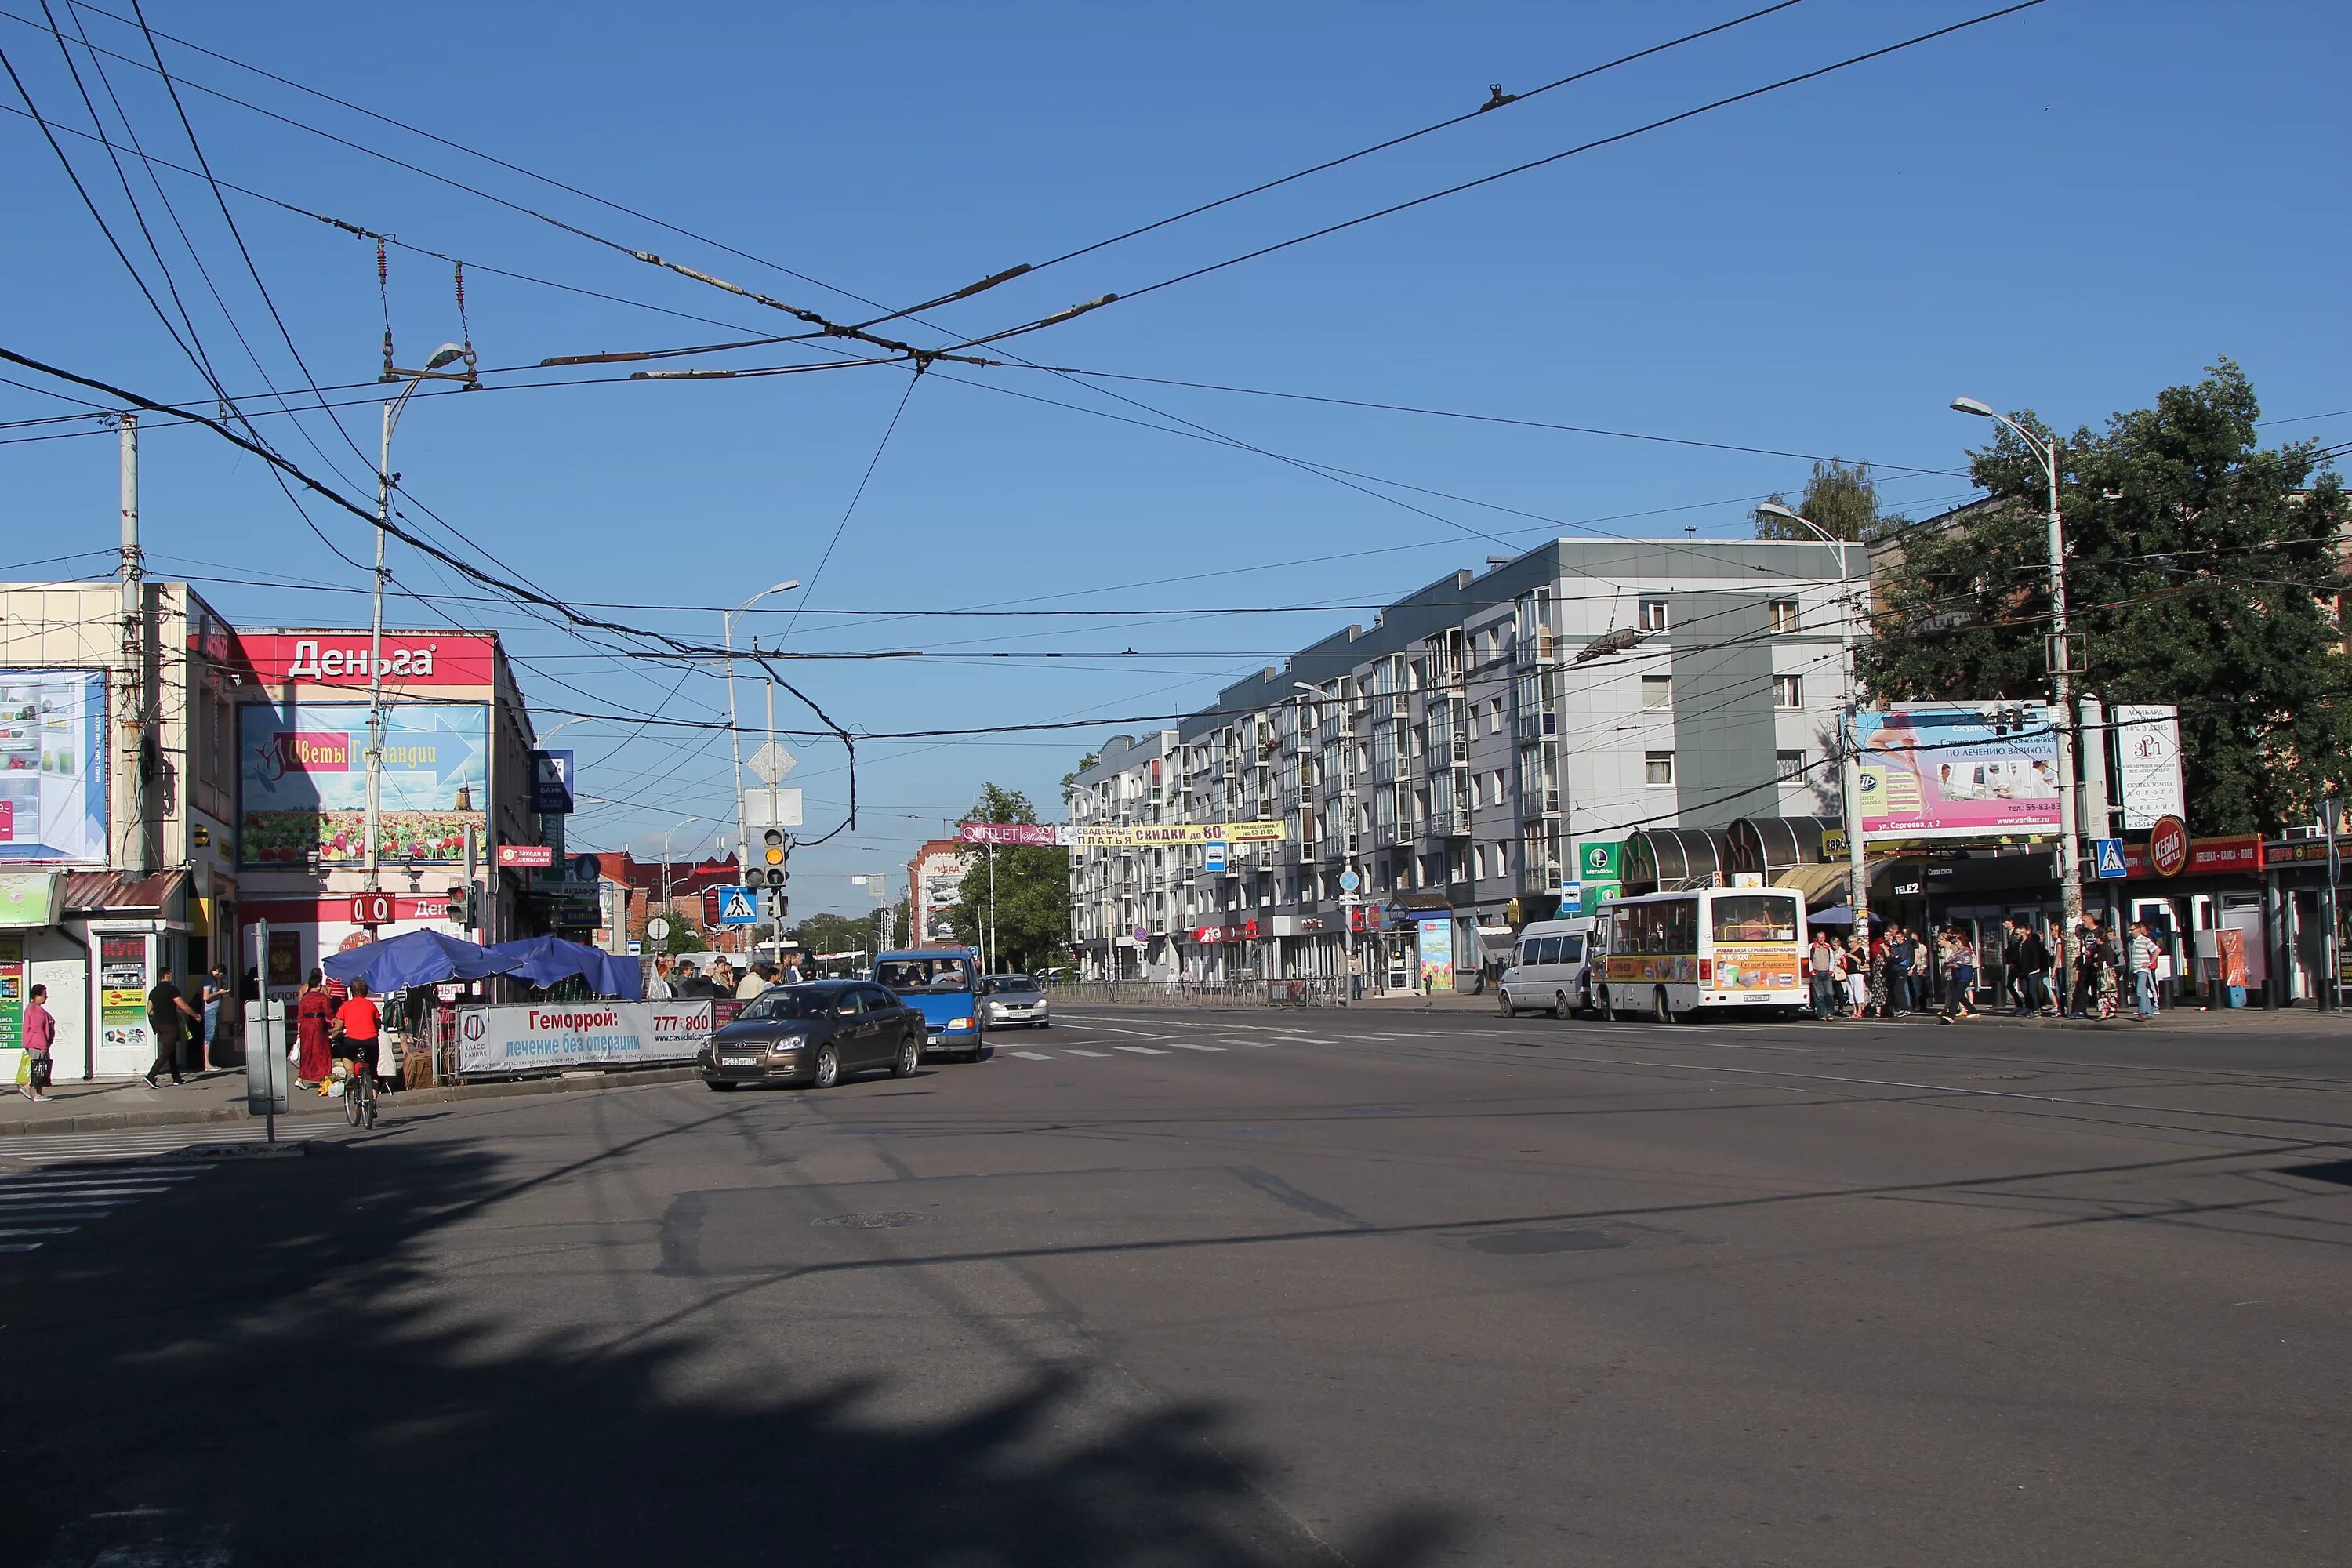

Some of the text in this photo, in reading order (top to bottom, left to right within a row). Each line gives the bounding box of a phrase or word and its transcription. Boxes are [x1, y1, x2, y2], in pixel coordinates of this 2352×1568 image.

[288, 640, 434, 680] Деньга
[289, 739, 437, 769] Цветы Голандии
[1962, 747, 2005, 757] ЛЕЧЕНИЮ
[2008, 746, 2052, 755] ВАРИКОЗА
[2026, 802, 2061, 811] 65-83-83
[1878, 822, 1889, 831] ул.
[1890, 821, 1926, 831] Сергеева,
[1935, 819, 1941, 828] 2
[1997, 816, 2049, 825] www.varikoz.ru
[1077, 826, 1229, 841] СВАДЕБНЫЕ СКИДКИ до 80%
[1078, 836, 1132, 845] ПЛАТЬЯ
[2155, 829, 2180, 861] КЕБАБ
[1894, 882, 1920, 895] TELE2
[414, 900, 452, 918] Ден
[529, 1007, 619, 1032] Геморрой:
[653, 1016, 677, 1032] 777
[686, 1015, 709, 1030] 800
[505, 1032, 641, 1058] лечение без операции
[655, 1033, 706, 1042] www.class-clinic.co
